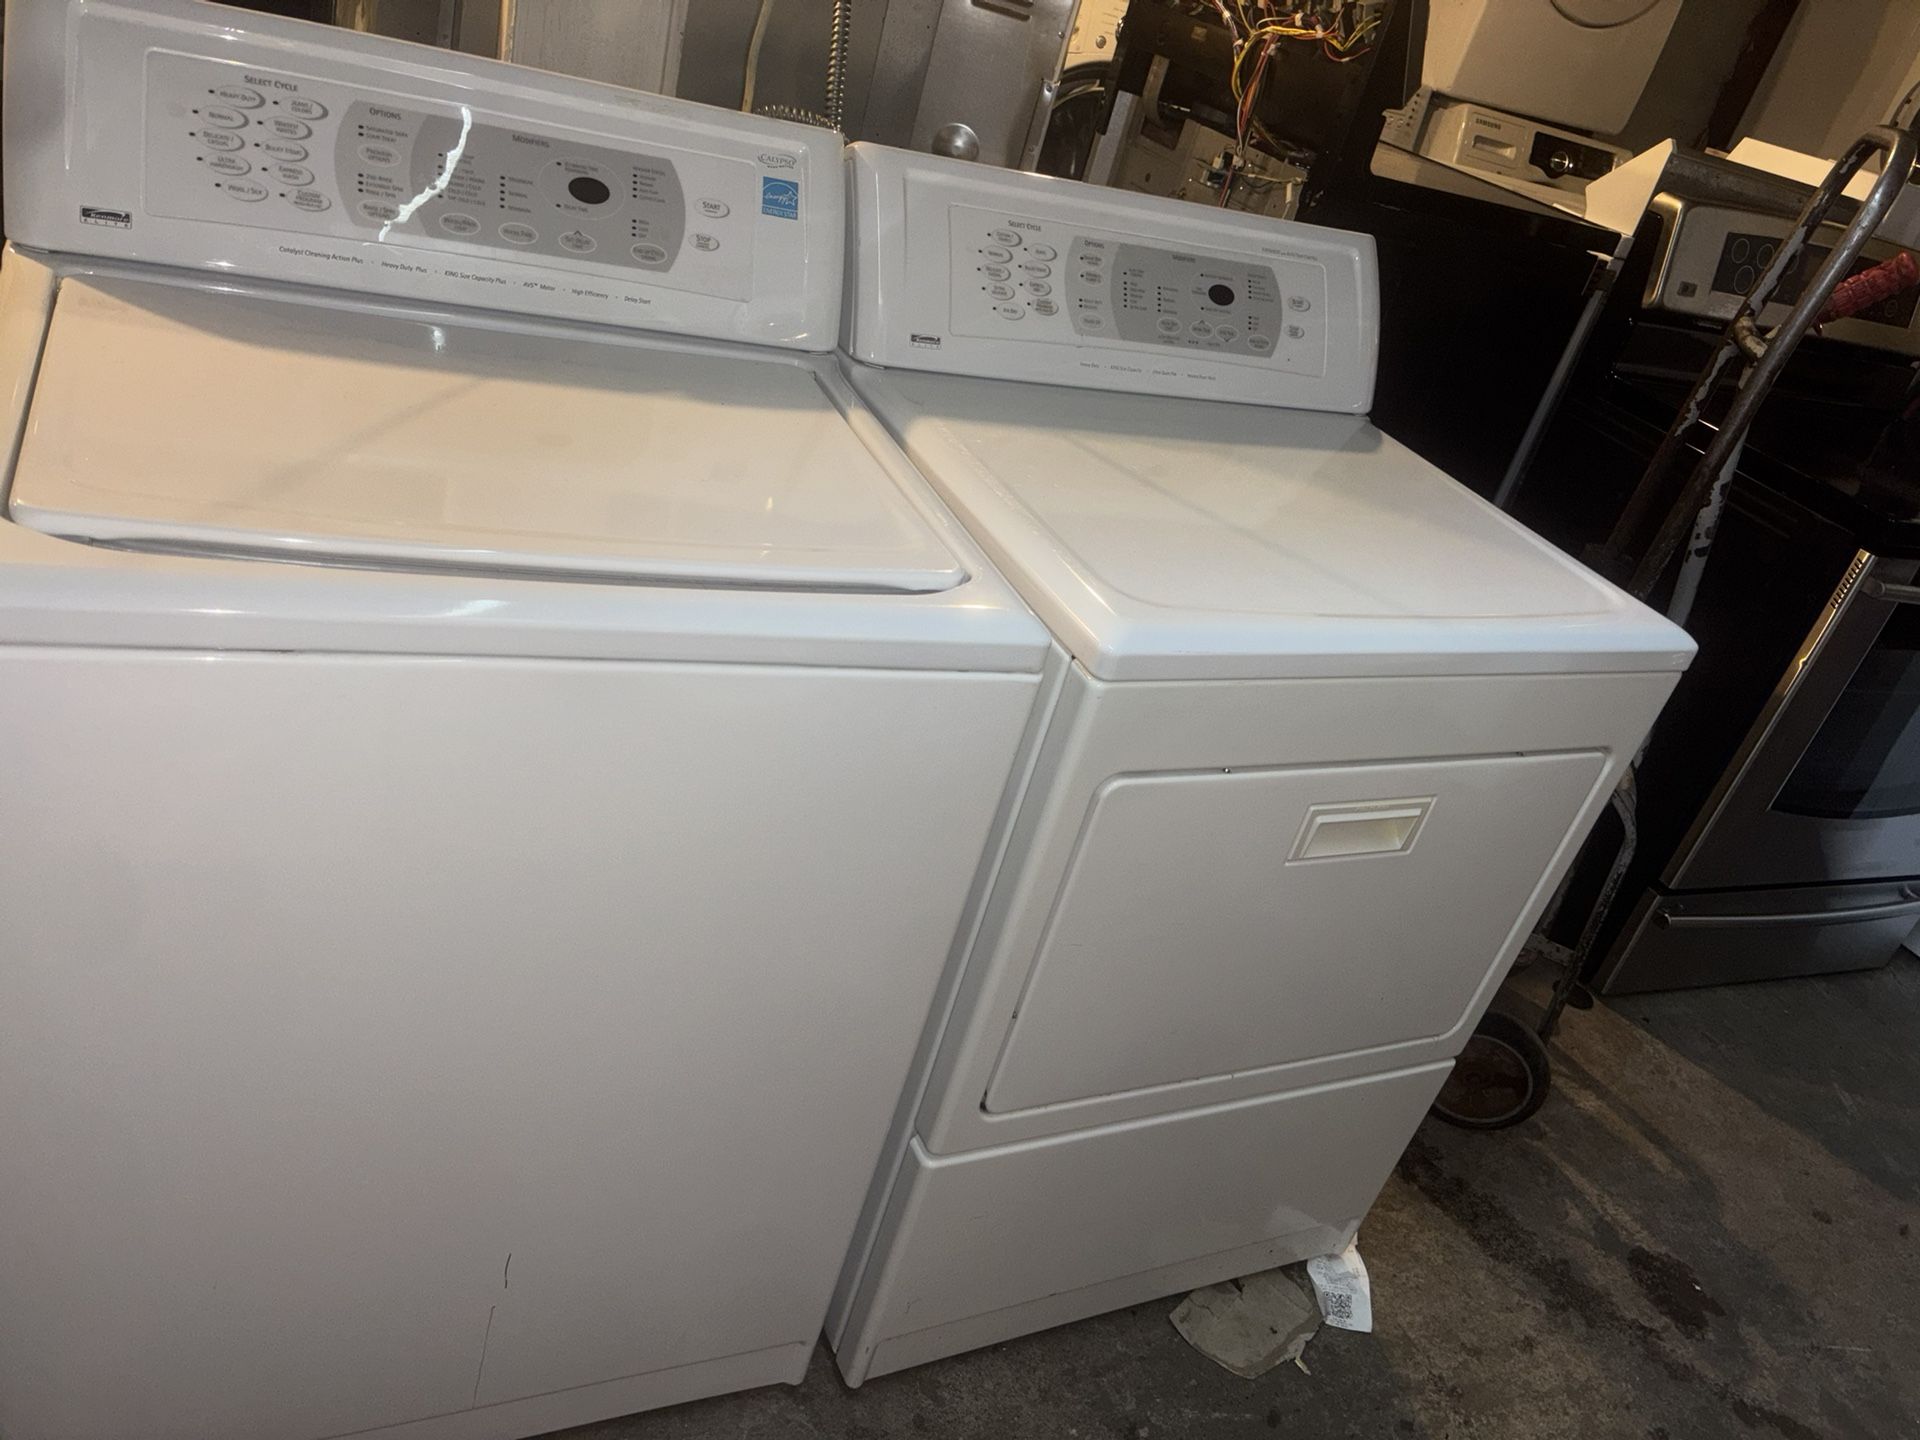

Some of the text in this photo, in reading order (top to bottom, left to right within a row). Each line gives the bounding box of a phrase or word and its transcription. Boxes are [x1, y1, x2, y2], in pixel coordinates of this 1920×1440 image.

[244, 75, 298, 92] SELECT CYCLE
[208, 111, 235, 122] NORMAL
[369, 107, 402, 120] OPTIONS
[1475, 118, 1501, 130] SAMSUNG
[512, 134, 550, 148] MODIFIERS
[760, 153, 796, 166] CALYPSO
[702, 201, 721, 211] START
[1008, 220, 1041, 232] SELECT CYCLE
[279, 245, 364, 264] Catalyst Cleaning Action Plus
[381, 261, 427, 273] Heavy Duty Plus
[459, 272, 470, 280] Size
[471, 274, 495, 284] Capacity
[495, 277, 506, 285] Plus
[571, 288, 608, 300] High Efficiency
